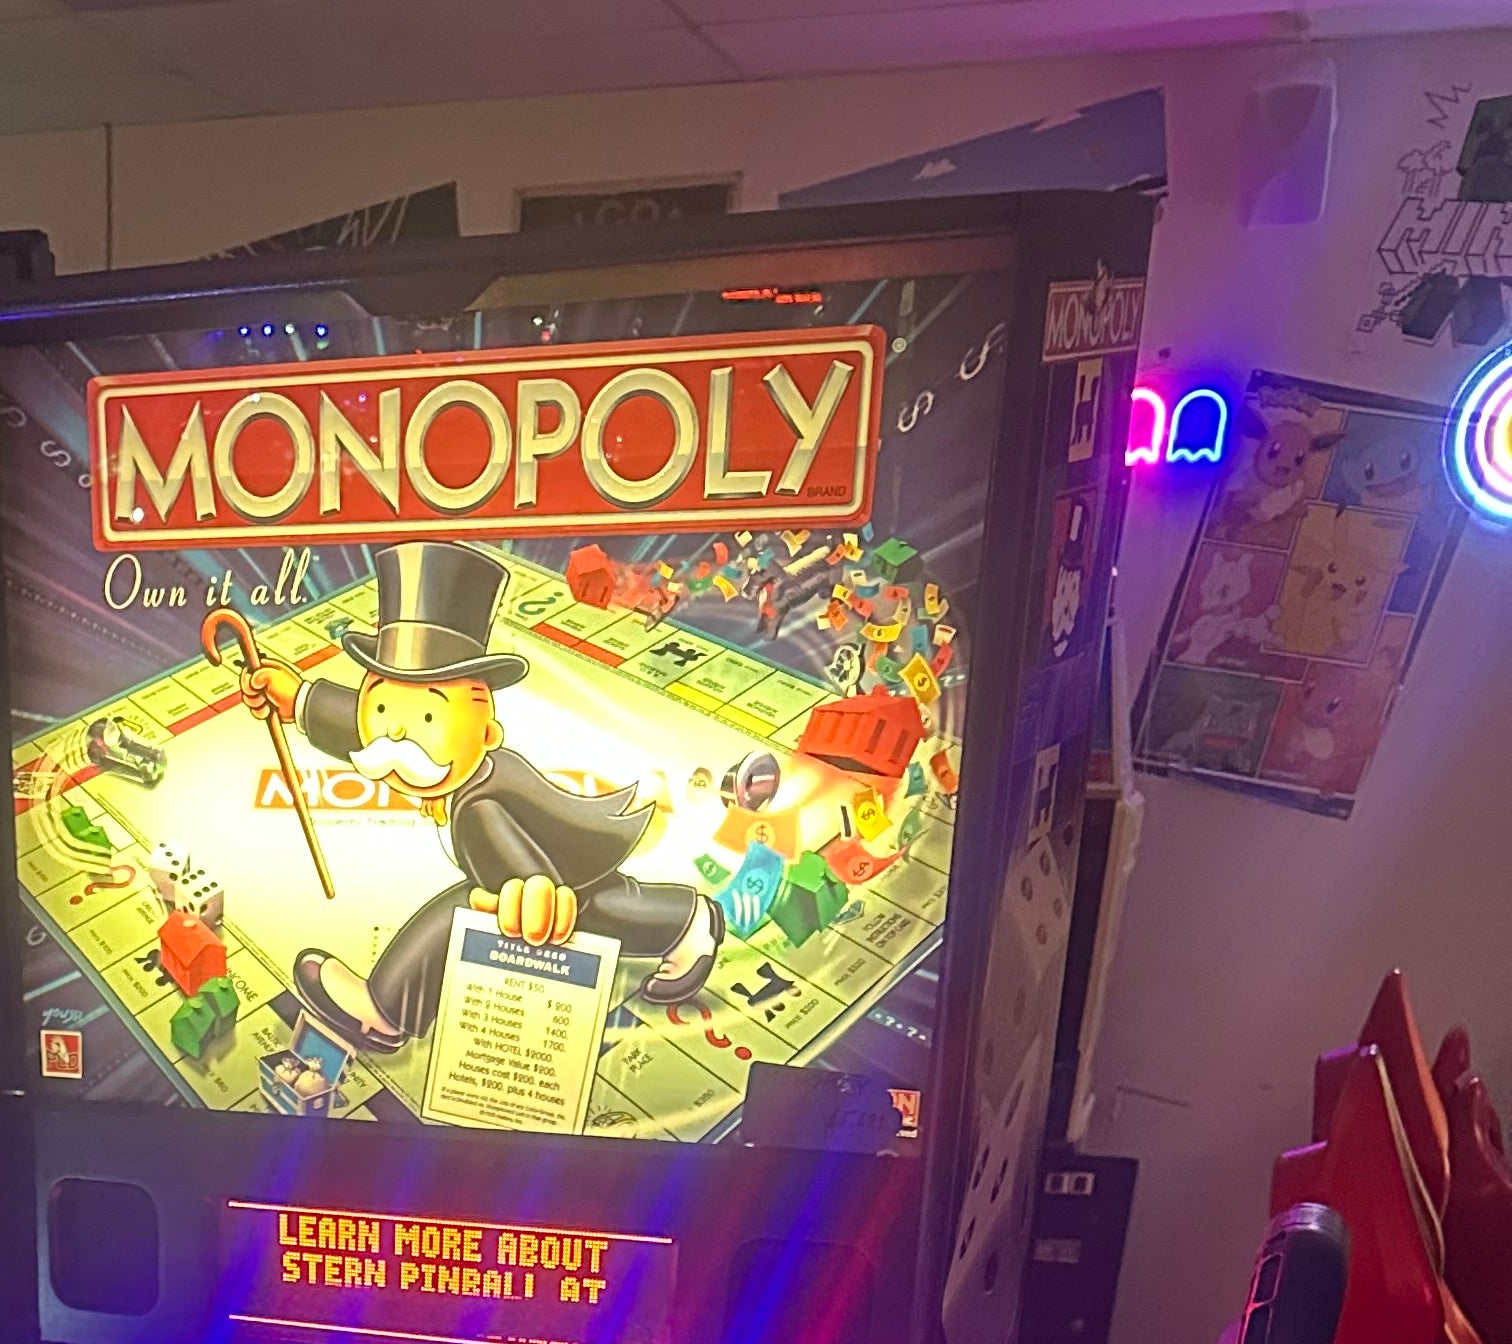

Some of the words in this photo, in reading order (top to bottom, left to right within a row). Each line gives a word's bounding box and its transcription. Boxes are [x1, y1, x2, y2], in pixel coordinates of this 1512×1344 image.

[116, 359, 855, 527] MONOPOLY
[805, 484, 849, 500] BRAND
[104, 553, 188, 610] Own
[206, 569, 233, 607] it
[496, 939, 531, 955] TITLE
[489, 949, 571, 976] BOARDWALK
[466, 983, 485, 994] With
[495, 990, 523, 1002] House
[504, 978, 526, 989] RENT
[528, 982, 545, 994] $50
[464, 995, 483, 1006] With
[493, 1002, 525, 1017] Houses
[461, 1008, 481, 1020] With
[491, 1015, 523, 1030] Houses
[459, 1021, 479, 1034] With
[489, 1028, 521, 1042] Houses
[473, 1037, 493, 1050] With
[494, 1041, 523, 1057] HOTEL
[621, 1046, 643, 1065] PARK
[465, 1049, 506, 1067] Mortgage
[508, 1057, 531, 1071] Value
[629, 1053, 654, 1076] PLACE
[458, 1060, 490, 1075] Houses
[491, 1068, 511, 1080] cost
[538, 1079, 561, 1092] each
[506, 1085, 526, 1097] plus
[535, 1090, 566, 1107] houses
[278, 1212, 381, 1254] LEARN
[393, 1223, 484, 1264] MORE
[497, 1232, 610, 1274] ABOUT
[281, 1251, 387, 1289] STERN
[559, 1276, 608, 1304] AT
